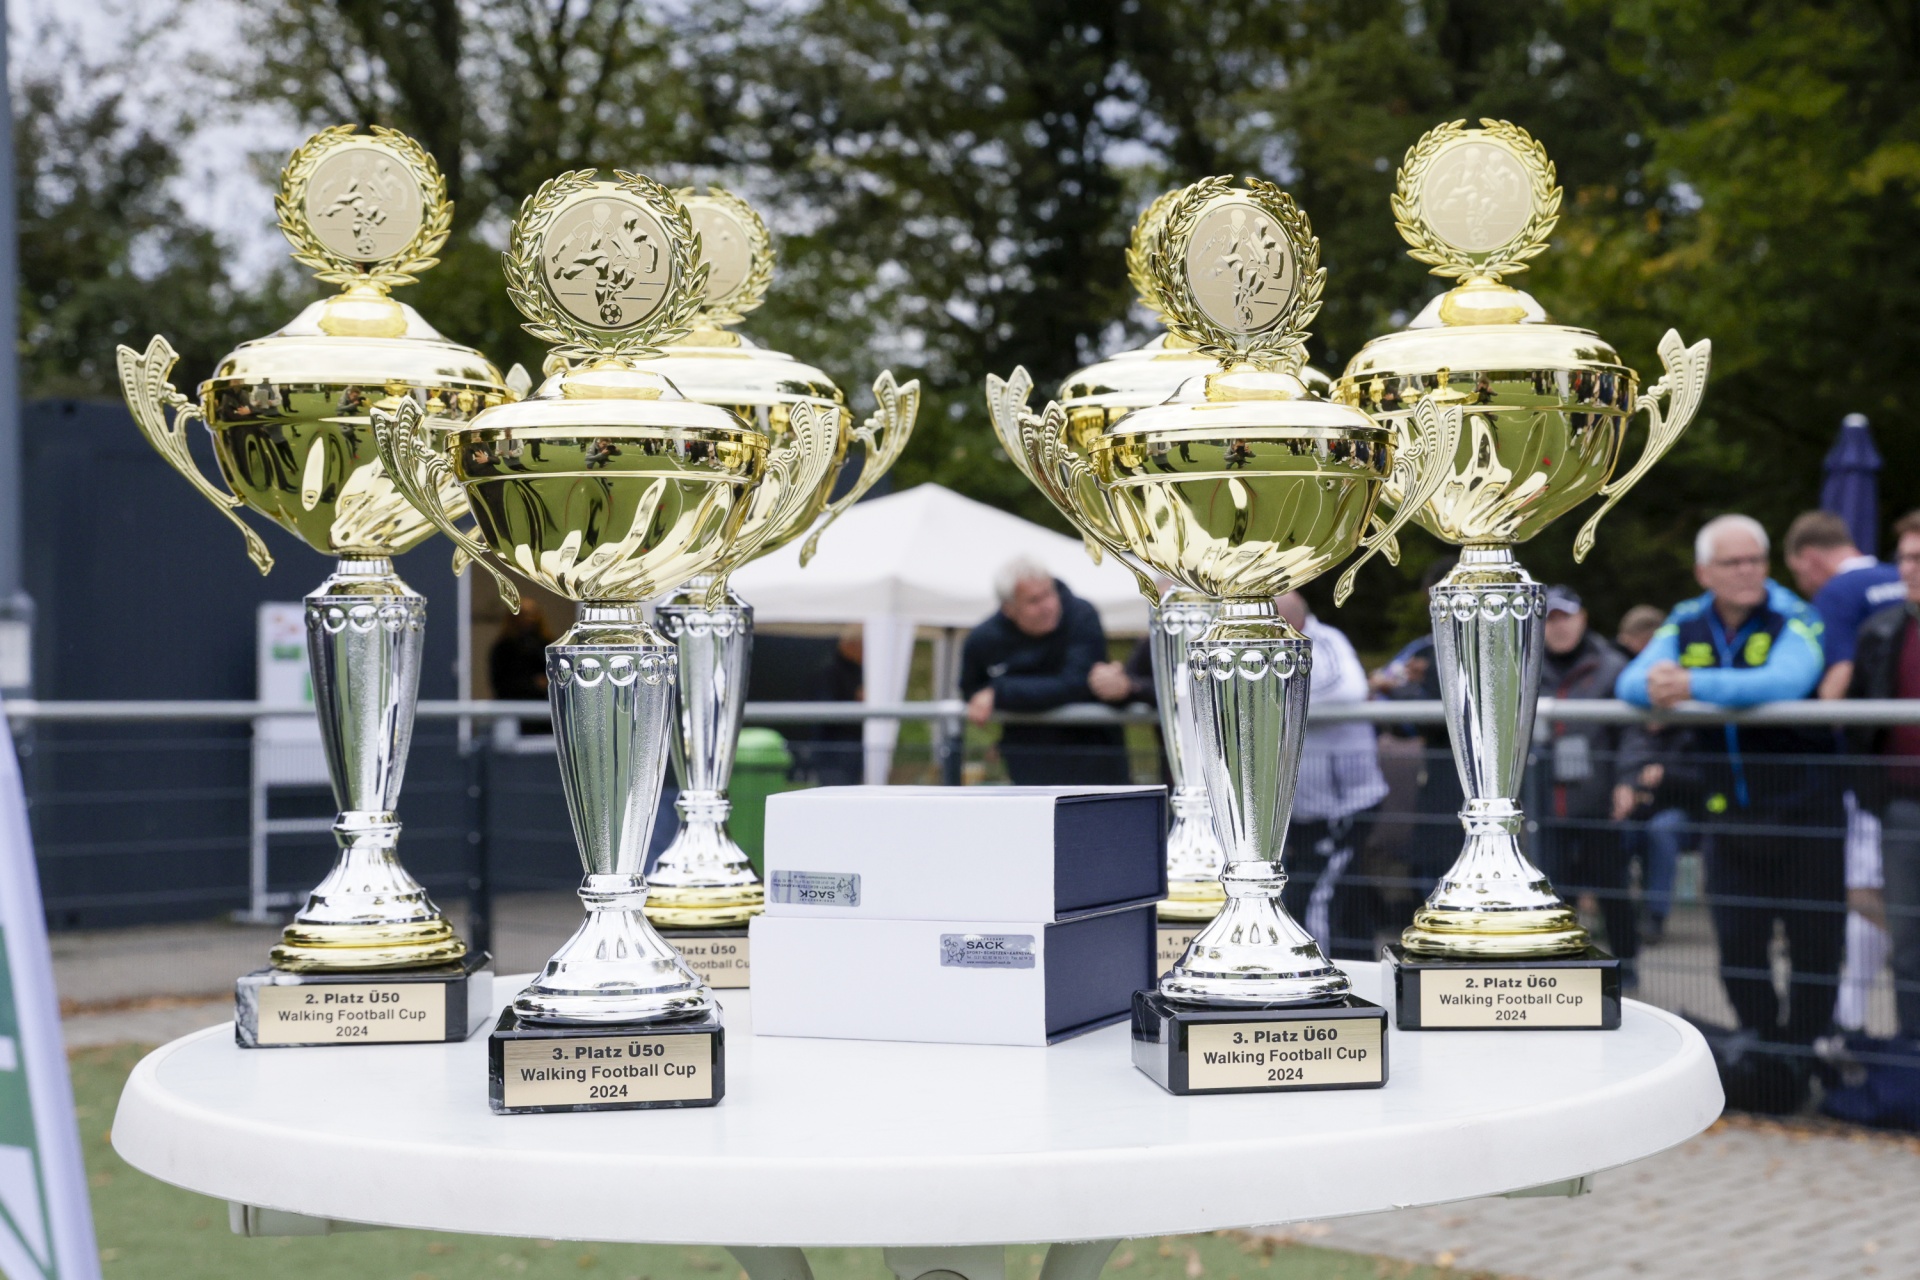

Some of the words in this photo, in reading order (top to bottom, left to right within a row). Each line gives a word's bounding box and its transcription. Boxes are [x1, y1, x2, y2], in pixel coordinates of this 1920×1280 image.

[799, 889, 835, 898] SACK
[966, 941, 1004, 950] SACK
[1168, 936, 1178, 945] 1.
[711, 943, 736, 954] Ü50
[1465, 978, 1478, 988] 2.
[1484, 977, 1522, 988] Platz
[1527, 974, 1557, 988] Ü60
[305, 994, 319, 1004] 2.
[325, 993, 364, 1004] Platz
[369, 990, 400, 1003] Ü50
[1439, 994, 1492, 1007] Walking
[1497, 994, 1552, 1004] Football
[1556, 993, 1583, 1006] Cup
[278, 1010, 333, 1022] Walking
[338, 1009, 394, 1020] Football
[399, 1008, 426, 1021] Cup
[1495, 1010, 1527, 1020] 2024
[336, 1026, 368, 1037] 2024
[1233, 1032, 1248, 1044] 3.
[1254, 1030, 1298, 1043] Platz
[1304, 1026, 1337, 1041] Ü60
[552, 1048, 569, 1060] 3.
[575, 1046, 622, 1059] Platz
[628, 1041, 665, 1058] Ü50
[1204, 1051, 1265, 1065] Walking
[1269, 1048, 1332, 1062] Football
[1336, 1046, 1367, 1061] Cup
[521, 1067, 586, 1082] Walking
[591, 1064, 658, 1079] Football
[664, 1063, 696, 1078] Cup
[1268, 1068, 1303, 1081] 2024
[589, 1085, 628, 1098] 2024
